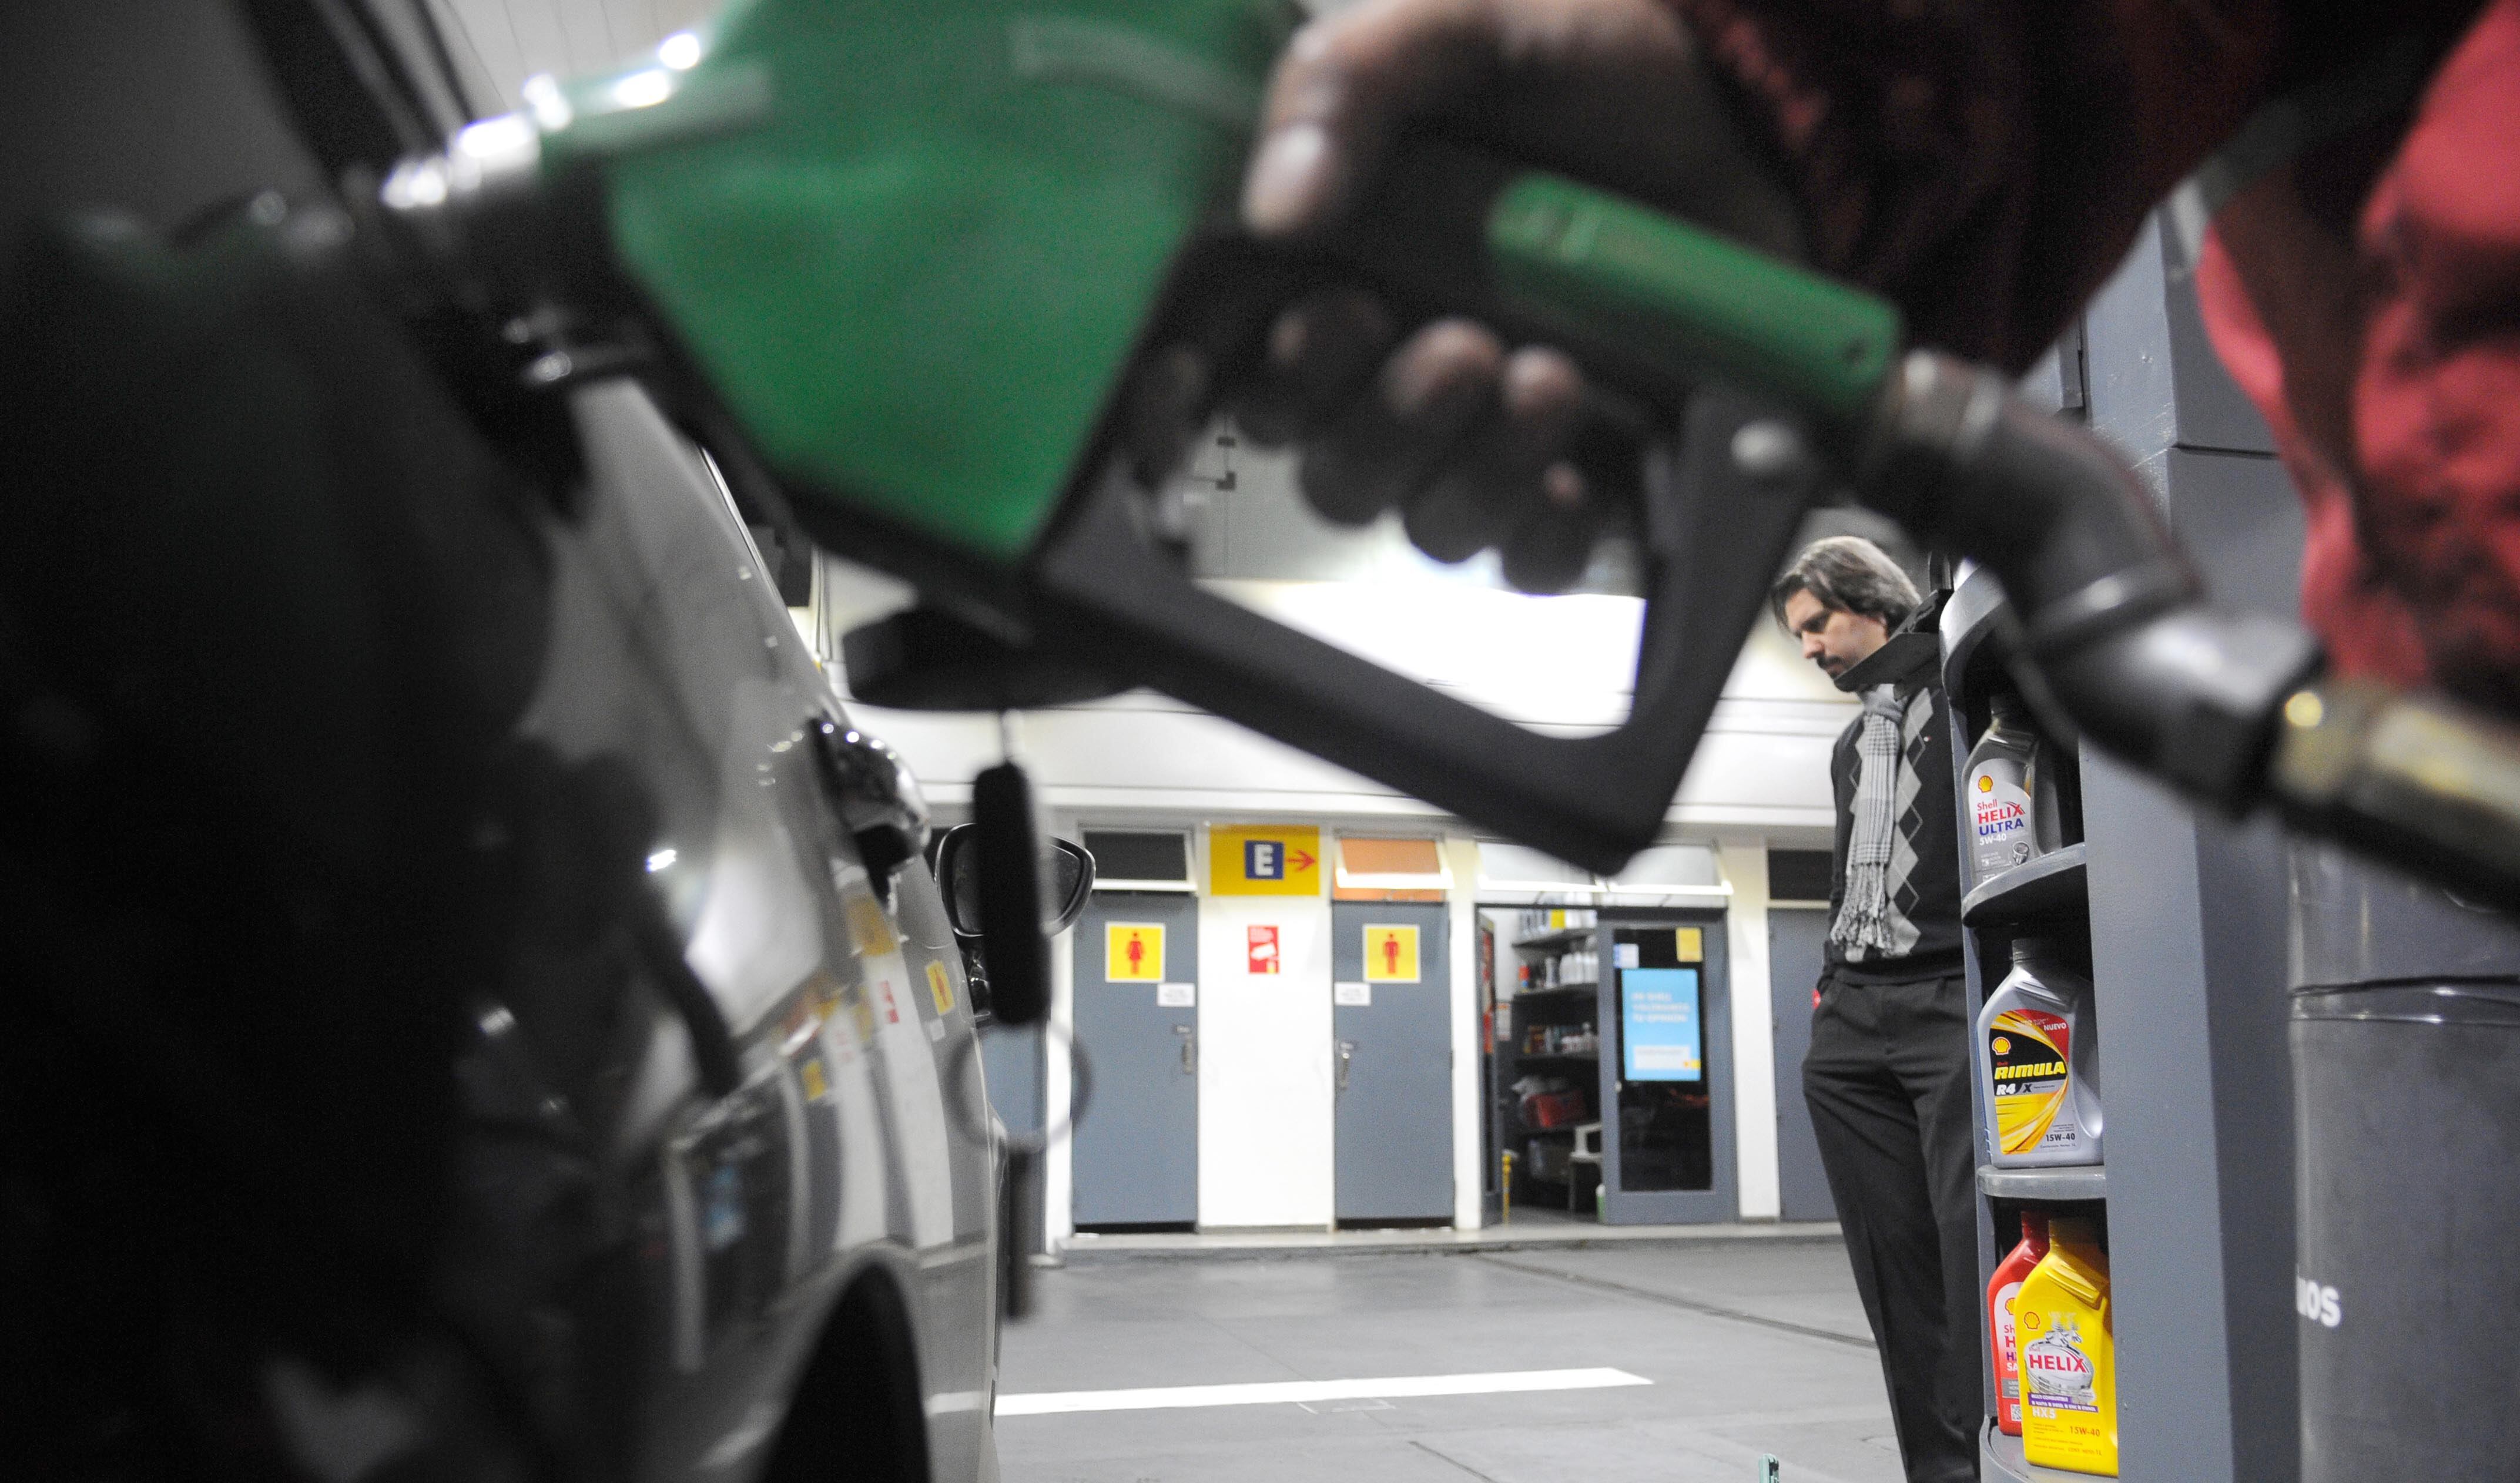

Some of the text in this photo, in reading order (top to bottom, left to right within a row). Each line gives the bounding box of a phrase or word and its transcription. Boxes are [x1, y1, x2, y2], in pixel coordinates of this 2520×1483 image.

[1977, 799, 1998, 811] Shell
[1978, 802, 2025, 824] HELIX
[1979, 818, 2024, 836] ULTRA
[1979, 833, 2007, 845] 5W-40
[1254, 844, 1274, 876] E
[2043, 1022, 2067, 1031] NUEVO
[1994, 1061, 2066, 1080] RIMULA
[1996, 1083, 2033, 1095] R4 X
[2046, 1132, 2076, 1142] 15W-40
[2029, 1353, 2088, 1373] HELIX
[2032, 1407, 2056, 1419] HX5
[2070, 1426, 2100, 1437] 15W-40
